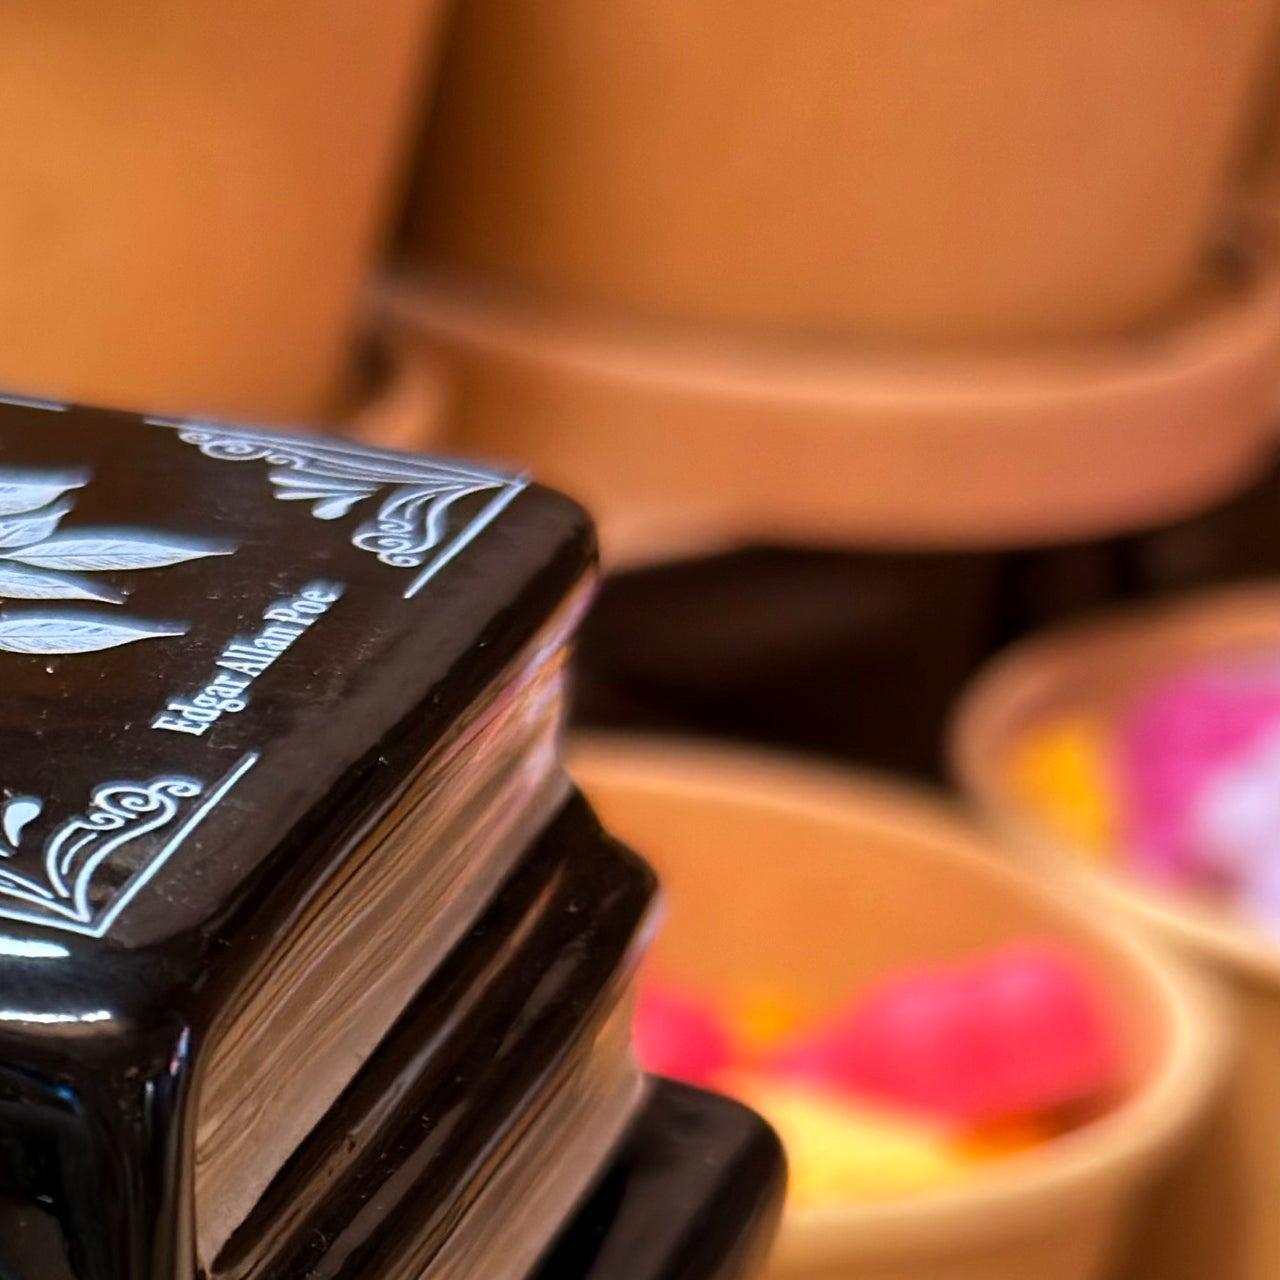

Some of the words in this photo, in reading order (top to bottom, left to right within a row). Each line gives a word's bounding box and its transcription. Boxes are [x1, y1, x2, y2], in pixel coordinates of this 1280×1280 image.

[151, 674, 251, 737] Edgar
[214, 625, 305, 679] Allan
[262, 587, 340, 627] Poe
